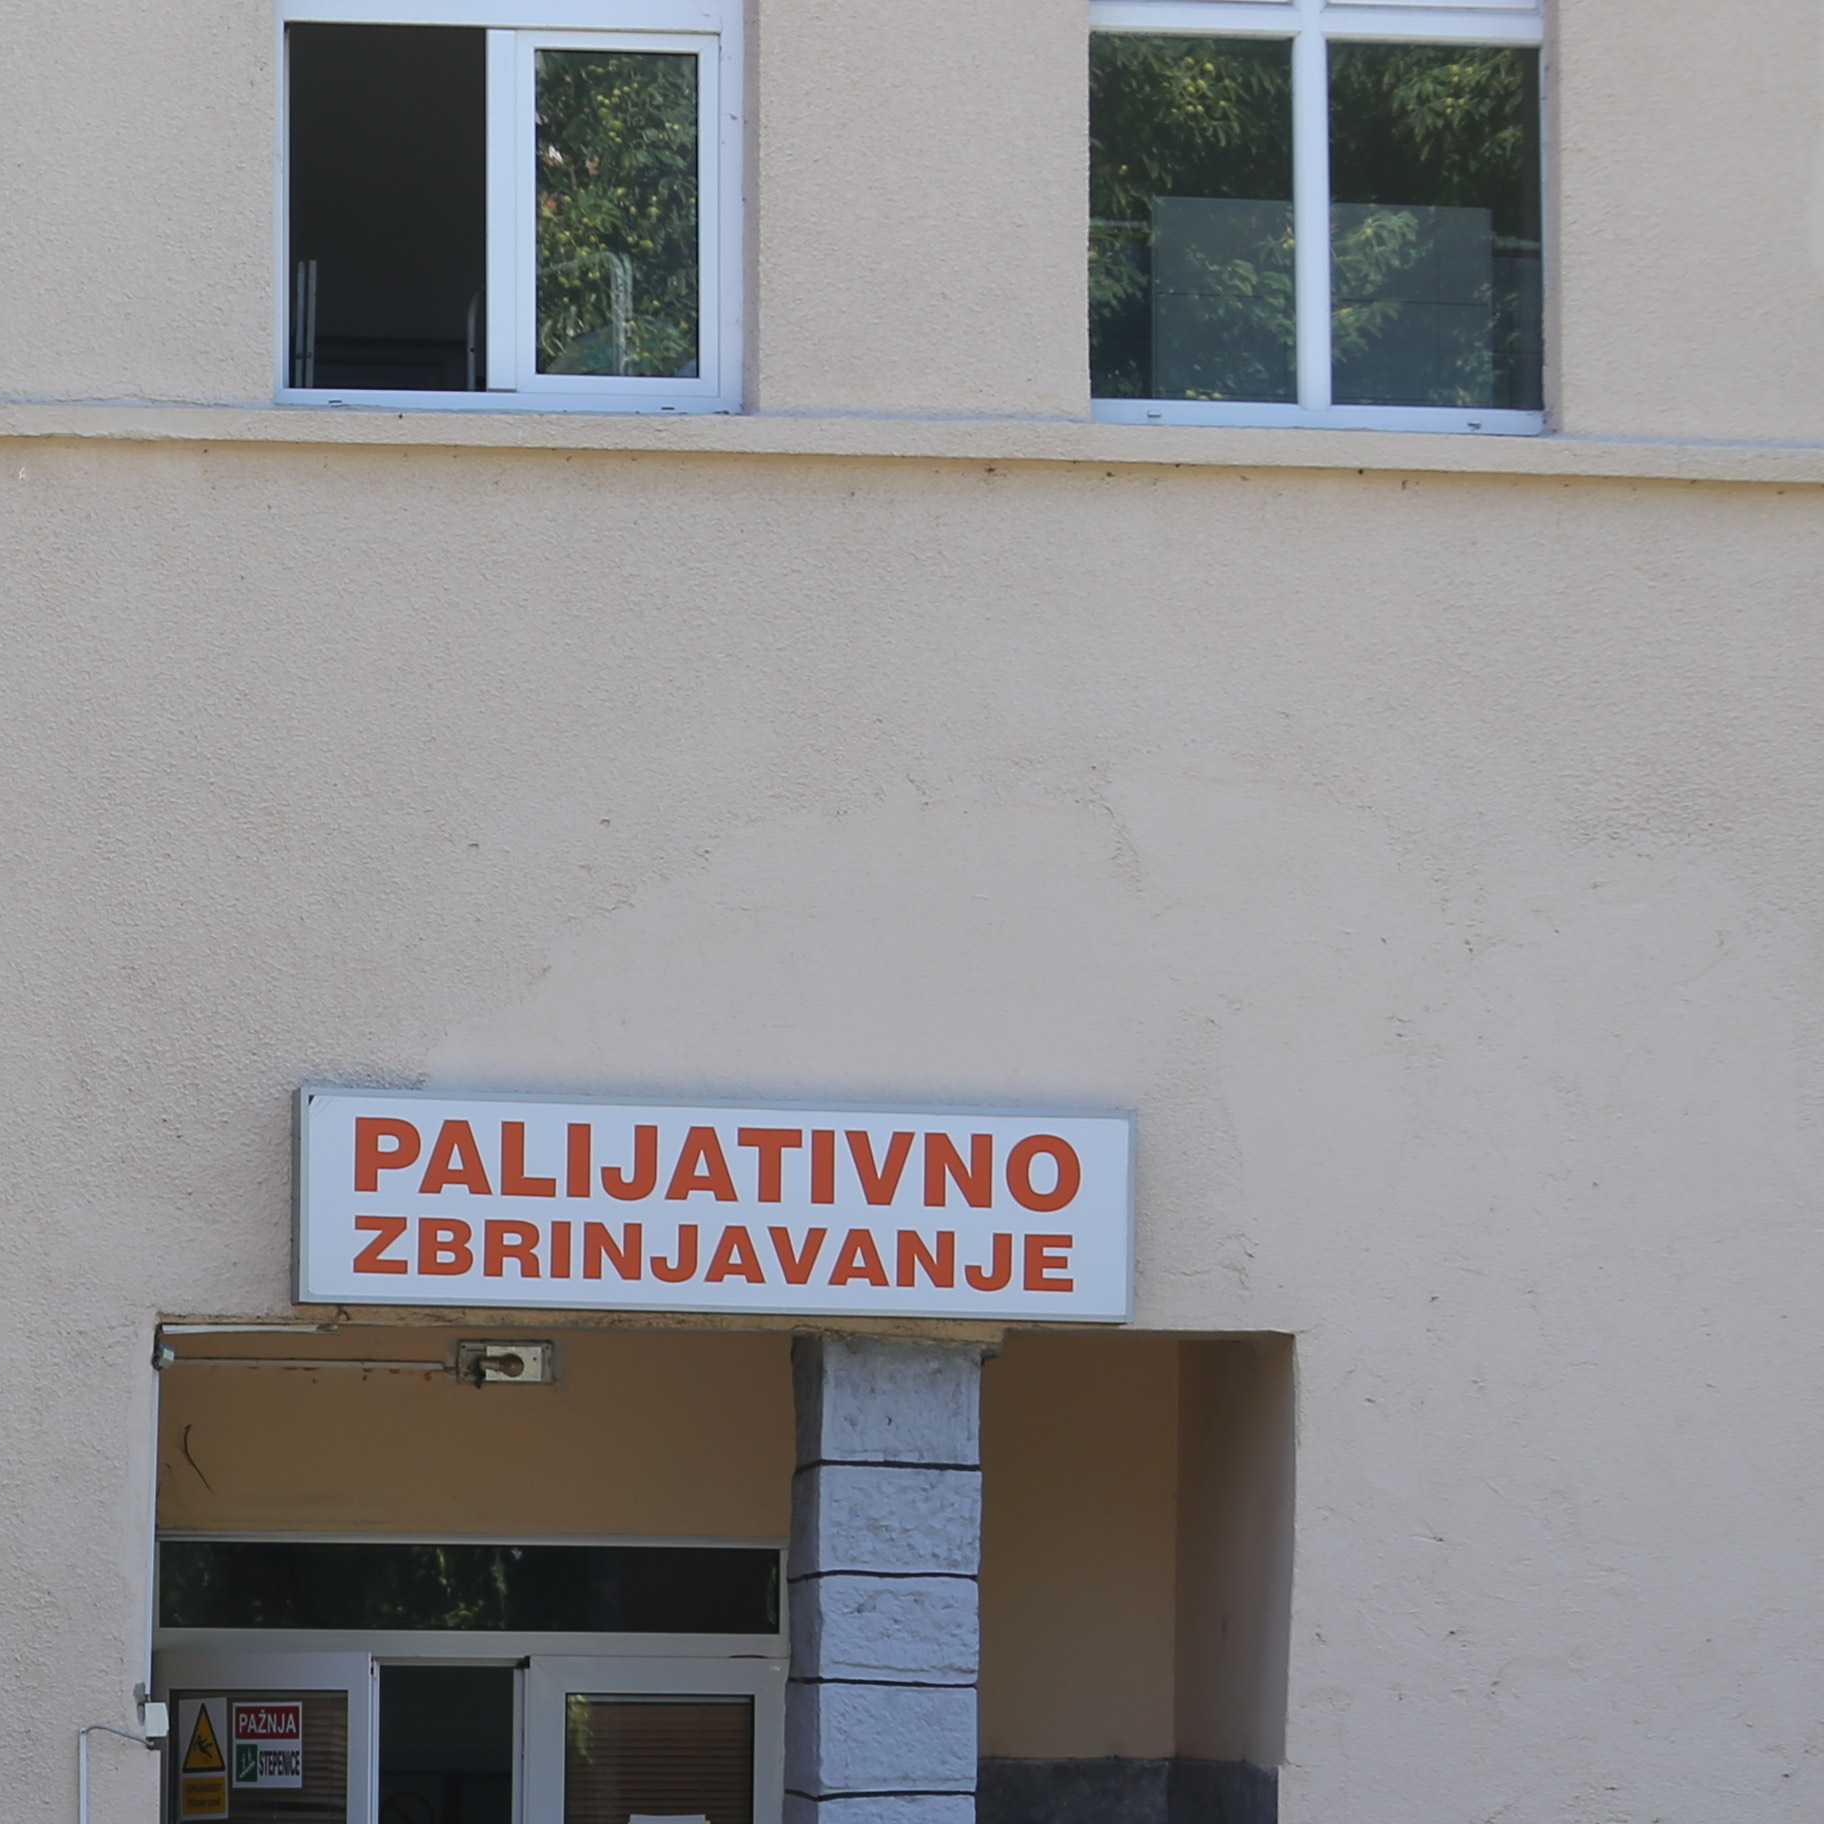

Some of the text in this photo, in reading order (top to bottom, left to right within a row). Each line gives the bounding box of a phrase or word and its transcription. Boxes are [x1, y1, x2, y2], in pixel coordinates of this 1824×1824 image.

[353, 1116, 1082, 1213] PALIJATIVNO
[352, 1214, 1074, 1293] ZBRINJAVANJE
[238, 1709, 297, 1734] PAŽNJA
[258, 1749, 301, 1777] STEPENICE
